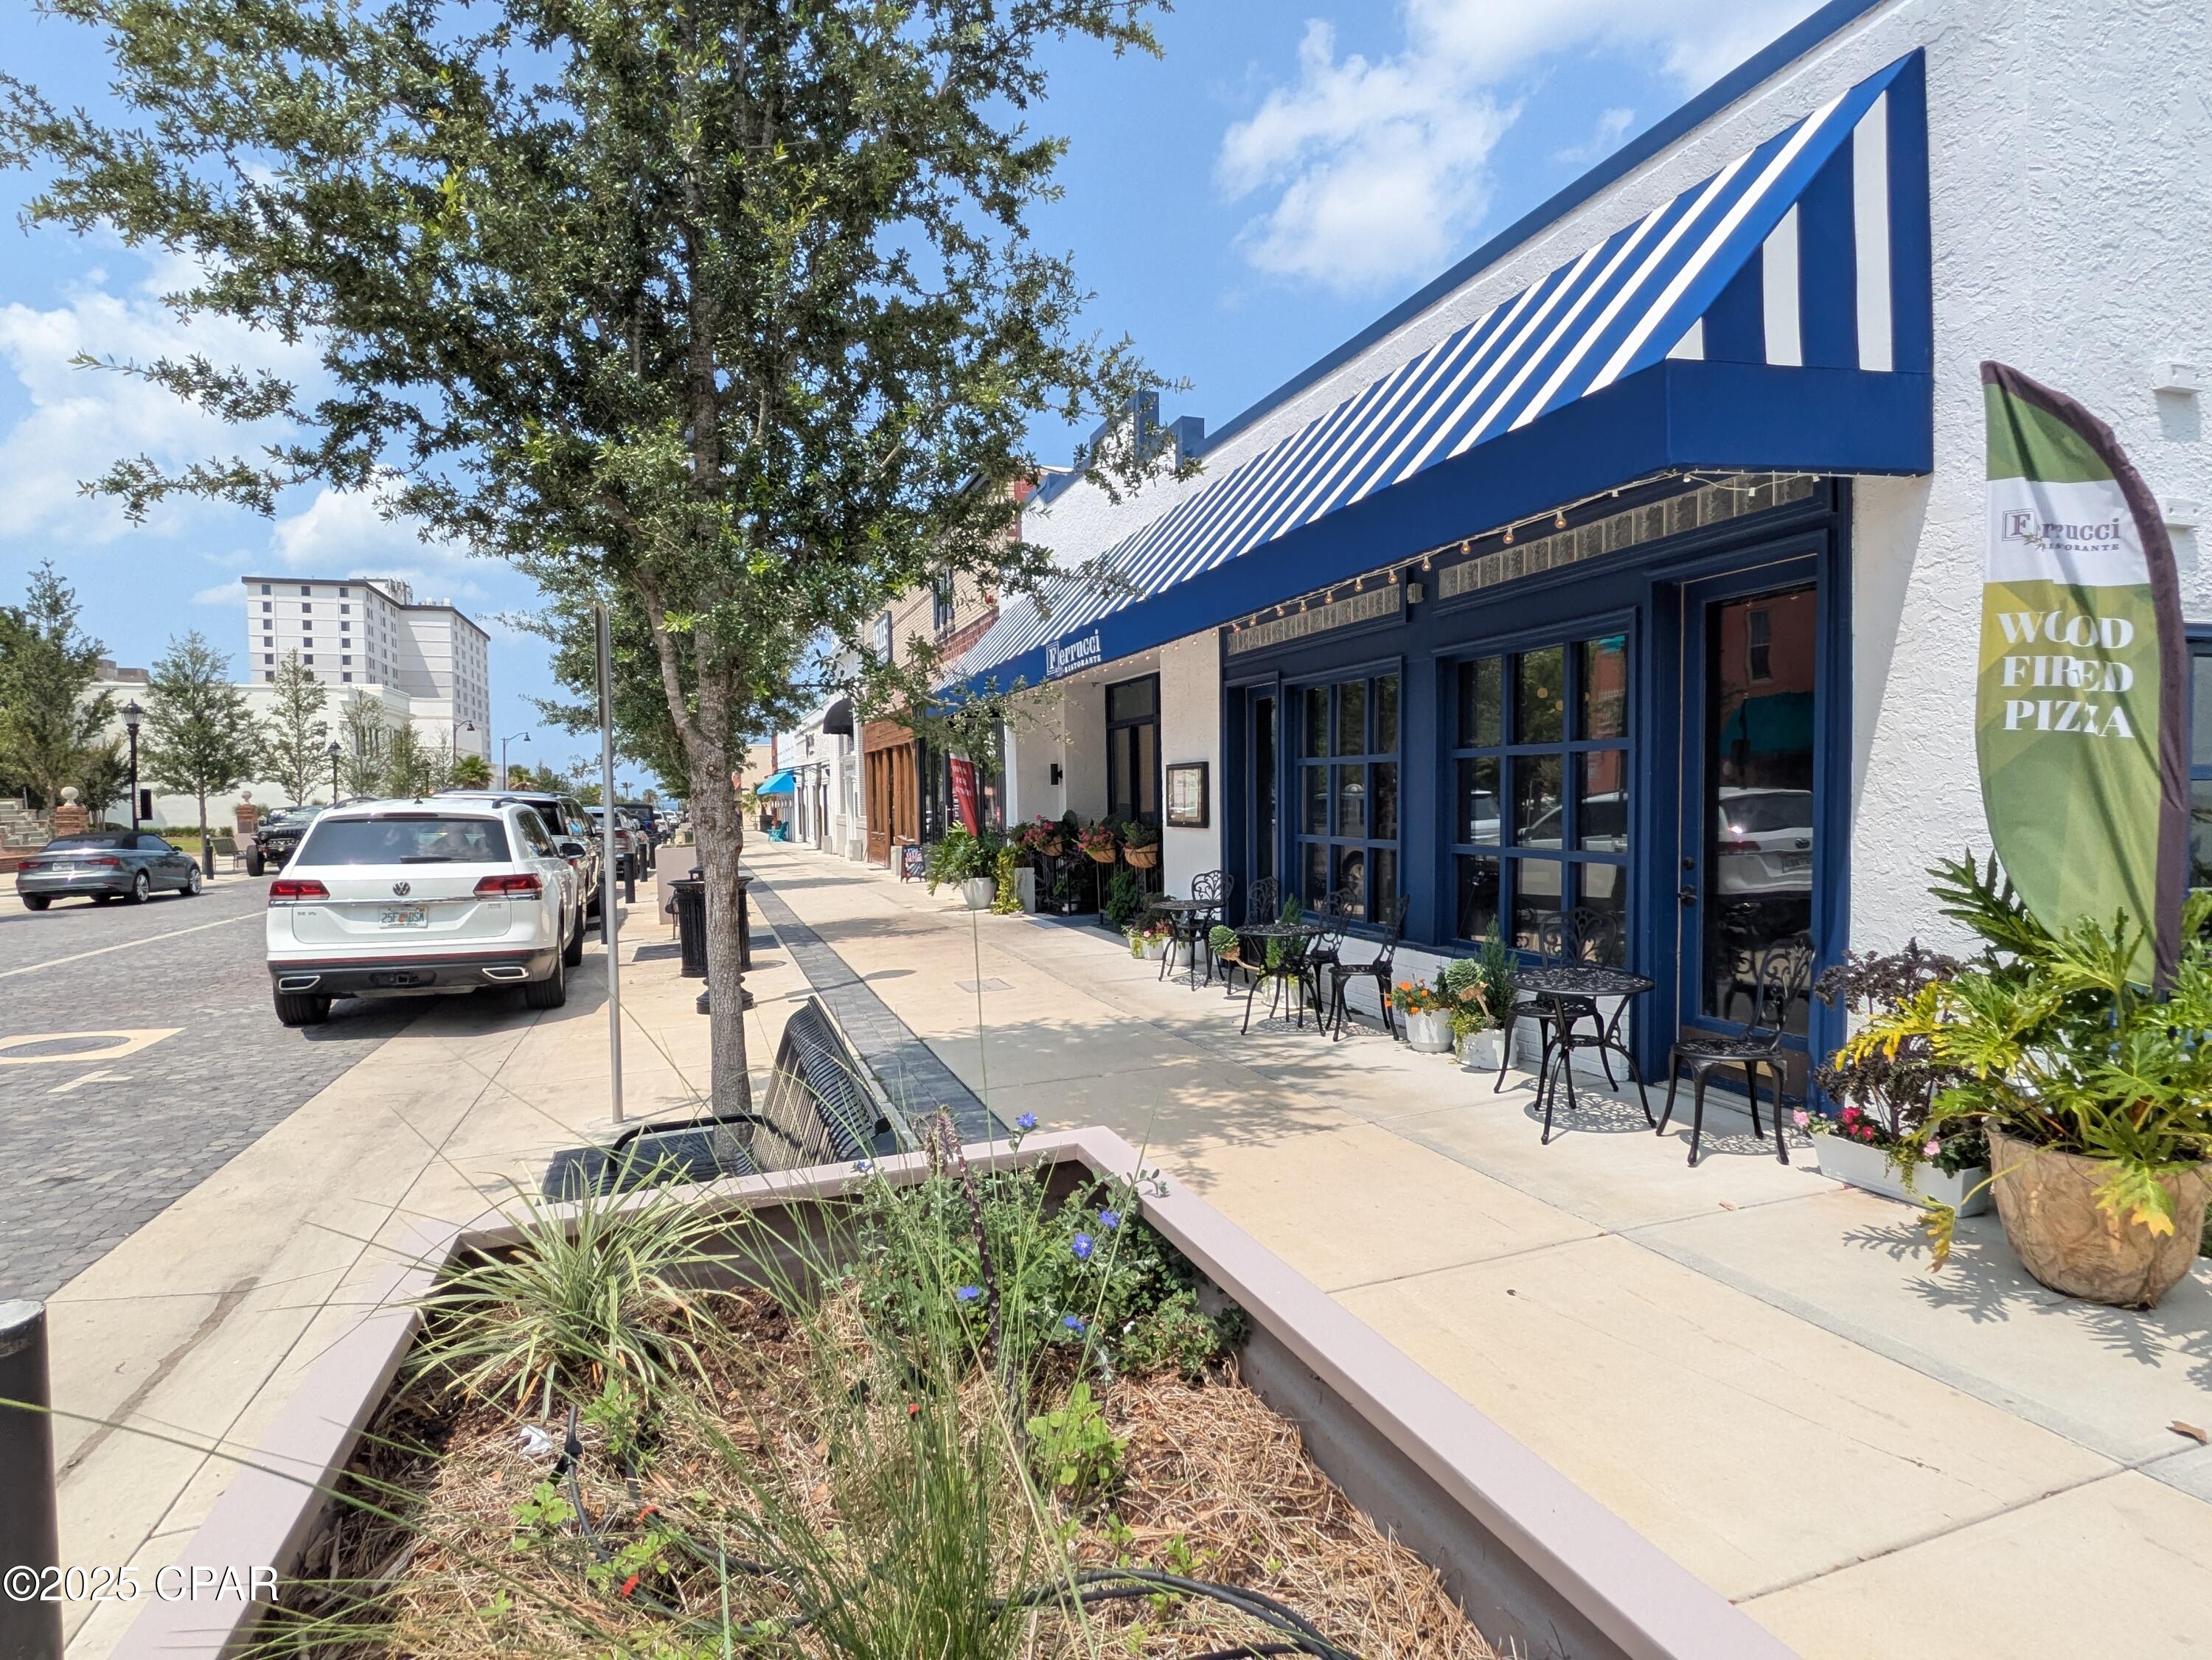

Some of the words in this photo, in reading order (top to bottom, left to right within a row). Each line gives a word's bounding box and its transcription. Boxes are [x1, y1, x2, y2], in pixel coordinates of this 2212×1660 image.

[2010, 513, 2121, 541] Frucci
[2039, 543, 2121, 551] ISORANTE
[1996, 610, 2134, 649] WOOD
[1048, 628, 1102, 670] Ferrucci
[1064, 654, 1102, 674] RISTORANTE
[2000, 655, 2134, 692] FIRED
[2002, 700, 2135, 738] PIZZA
